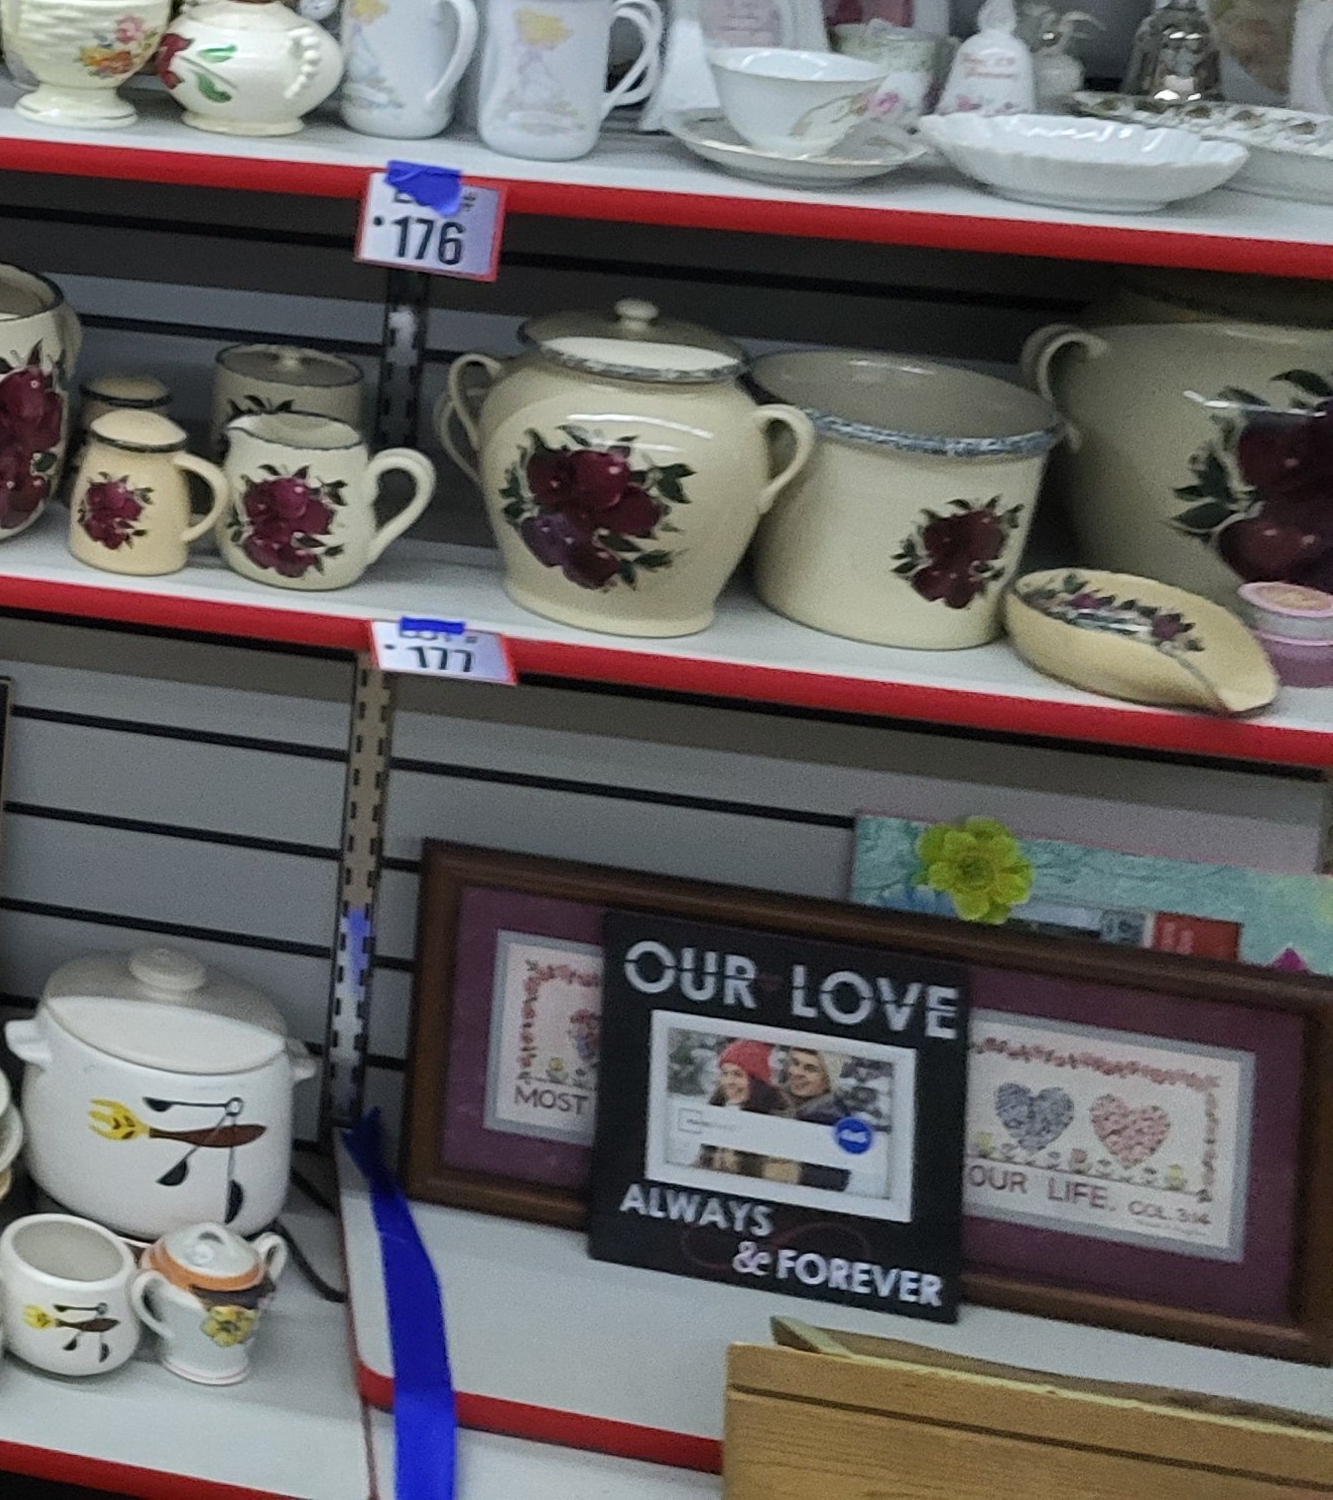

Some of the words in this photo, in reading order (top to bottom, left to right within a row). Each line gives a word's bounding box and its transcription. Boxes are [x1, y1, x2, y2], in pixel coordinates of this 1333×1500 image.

[392, 216, 465, 265] 176
[407, 646, 473, 672] 177
[624, 940, 757, 1009] OUR
[791, 964, 959, 1041] LOVE
[515, 1085, 589, 1115] MOST
[966, 1165, 1027, 1194] OUR
[619, 1183, 775, 1238] ALWAYS
[733, 1240, 772, 1277] &
[776, 1248, 942, 1307] FOREVER
